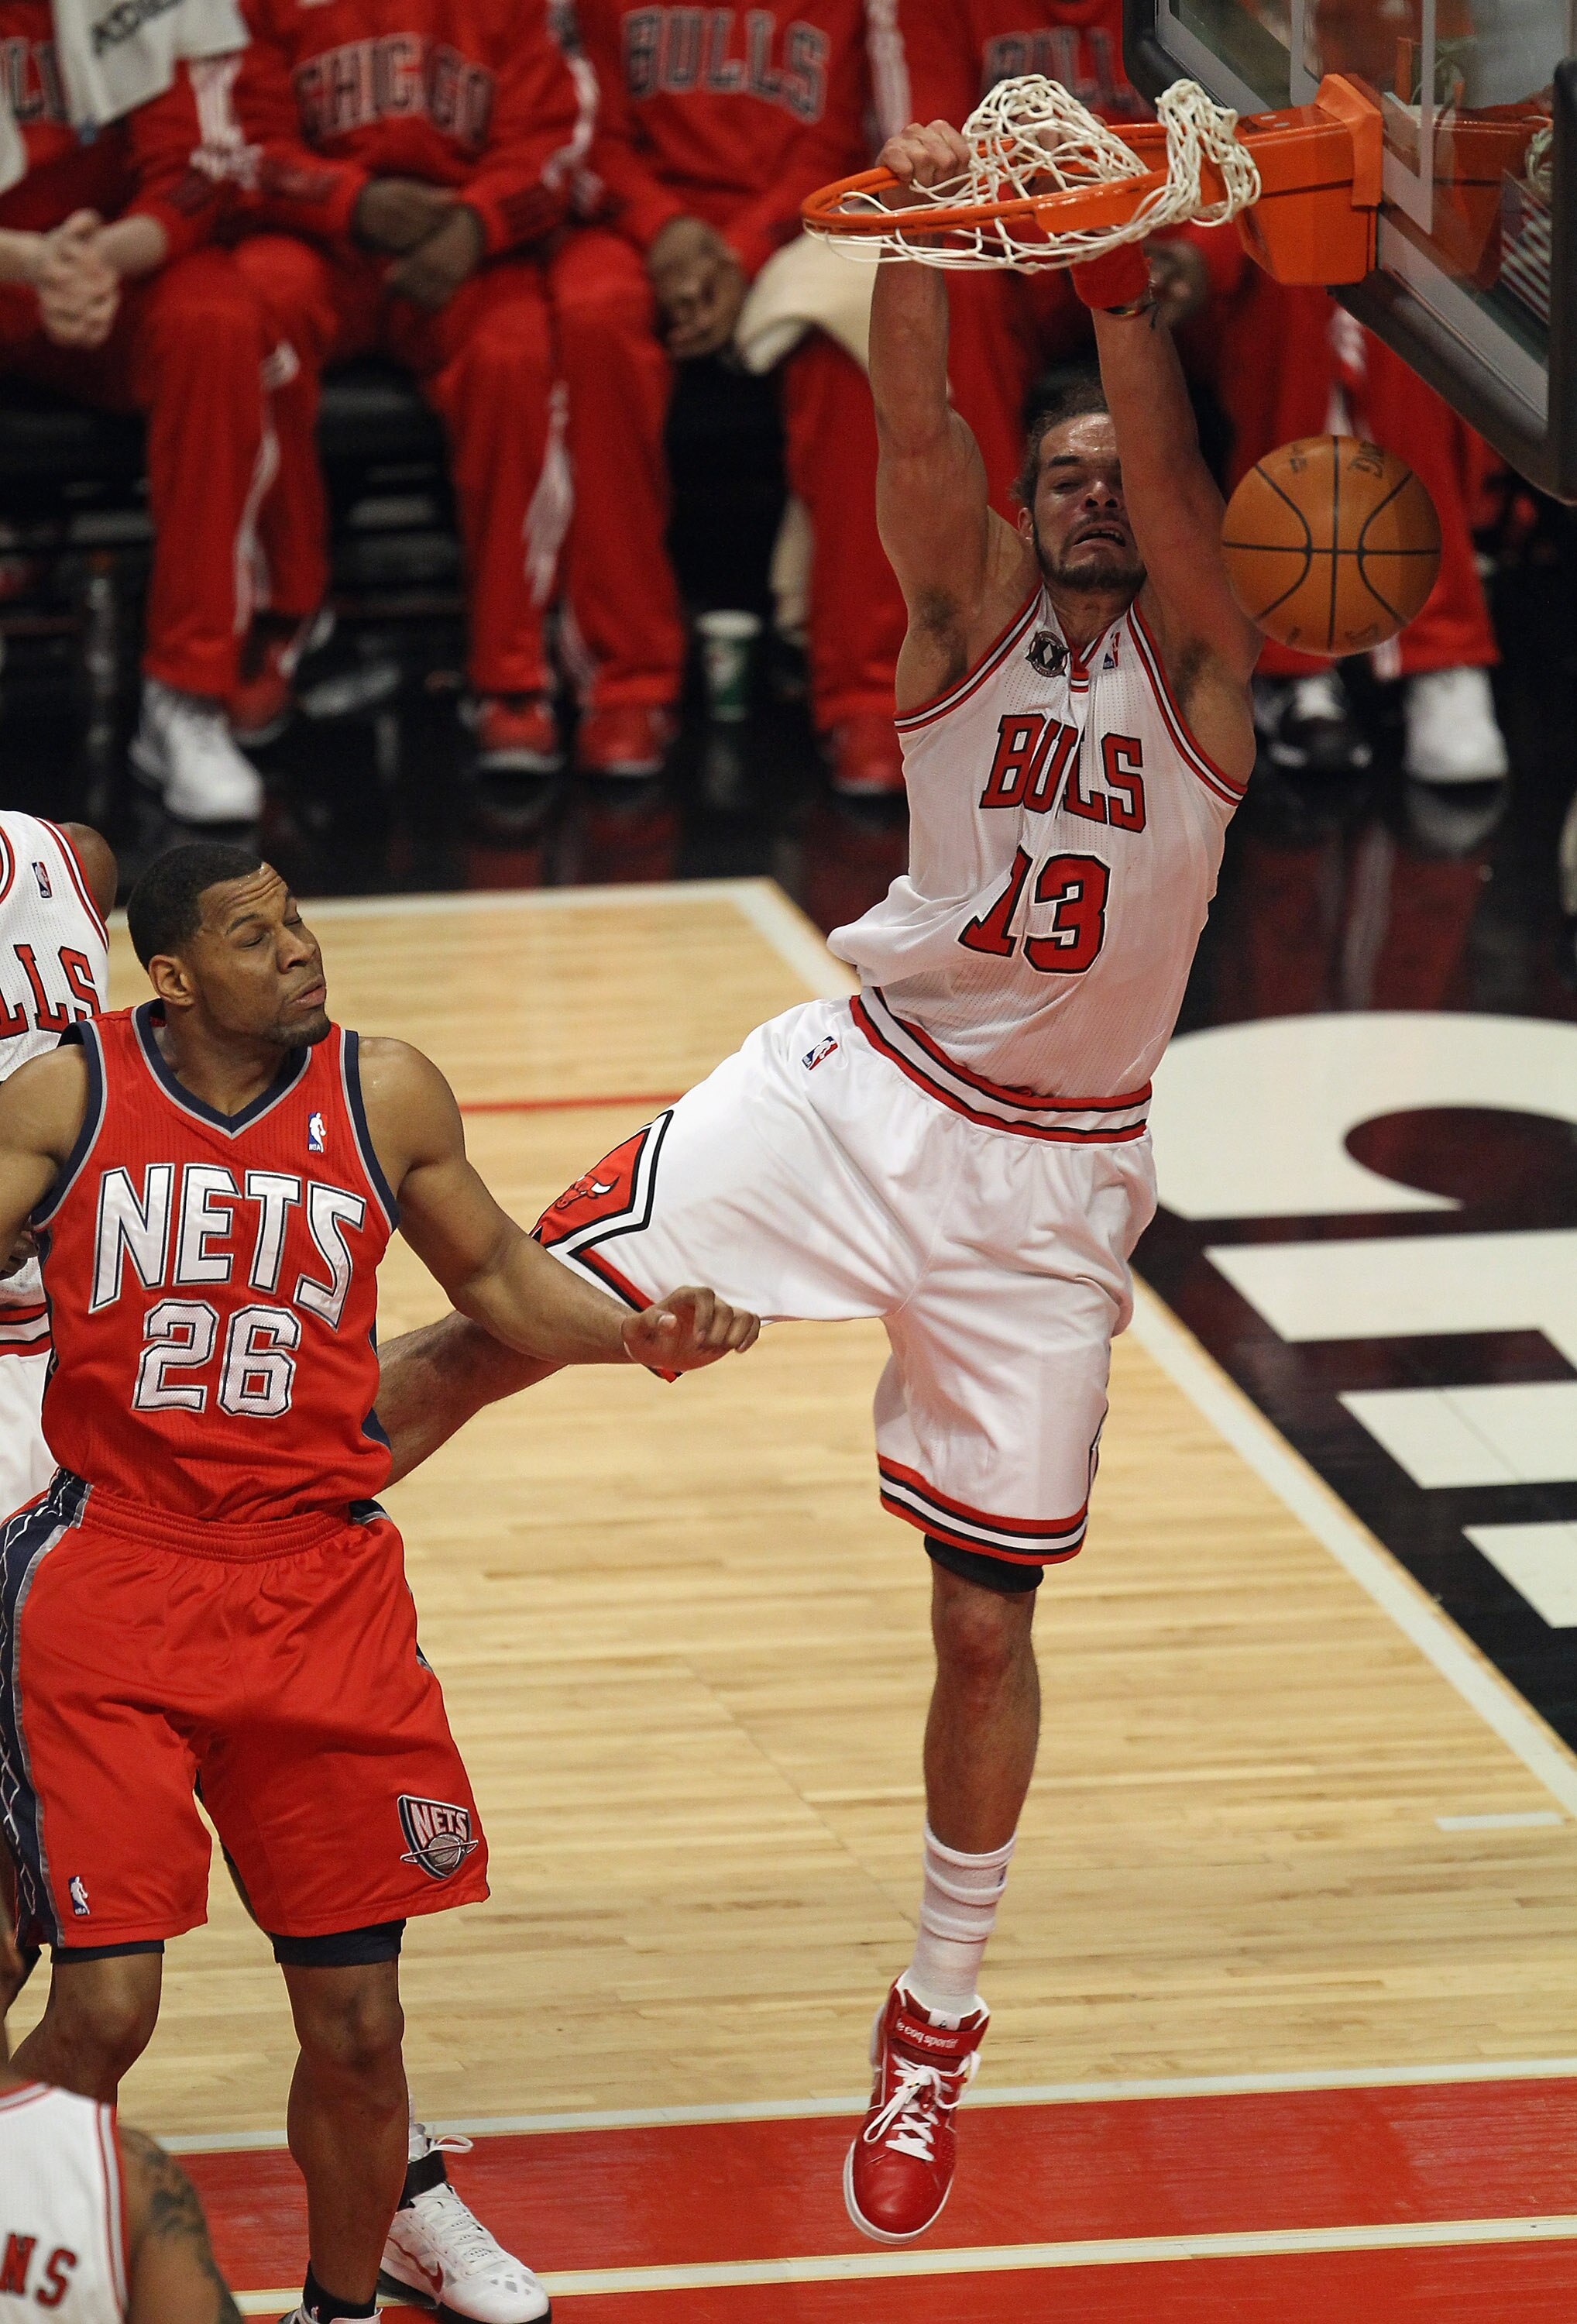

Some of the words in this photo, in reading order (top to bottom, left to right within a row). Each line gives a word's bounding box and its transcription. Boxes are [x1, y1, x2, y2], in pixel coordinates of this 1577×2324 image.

[622, 6, 830, 124] BULLS
[982, 26, 1139, 113] BULL
[957, 844, 1111, 975] 13
[88, 1162, 367, 1332] NETS
[130, 1298, 302, 1419] 26
[410, 1802, 467, 1849] NETS
[904, 2026, 925, 2044] coq
